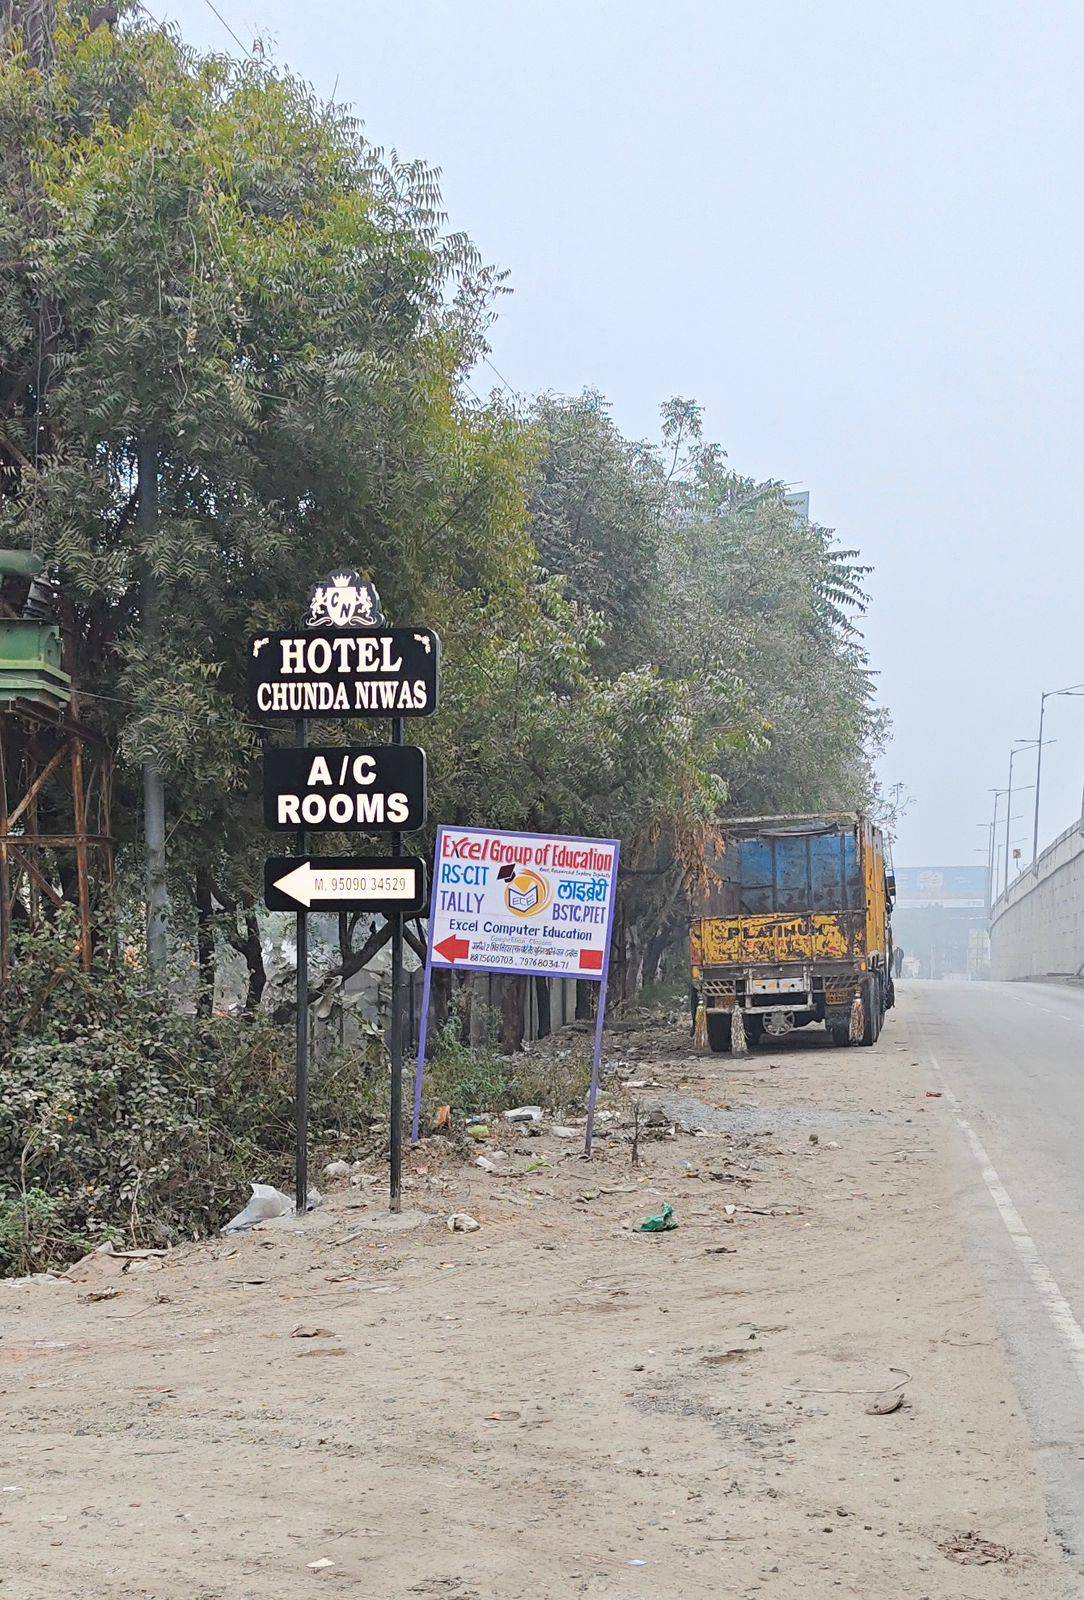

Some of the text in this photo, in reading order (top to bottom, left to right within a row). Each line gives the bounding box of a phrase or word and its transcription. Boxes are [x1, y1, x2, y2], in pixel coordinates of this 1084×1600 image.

[280, 637, 403, 674] HOTEL
[256, 680, 428, 711] CHUNDA NIWAS
[307, 755, 377, 786] A/C
[277, 793, 410, 824] ROOMS
[442, 835, 612, 871] Excel Group of Education
[314, 877, 406, 891] M. 95090 34529
[557, 877, 610, 902] लाइब्रेरी
[440, 890, 485, 914] TALLY
[449, 919, 478, 932] Excel
[483, 921, 540, 937] Computer
[542, 926, 592, 941] Education
